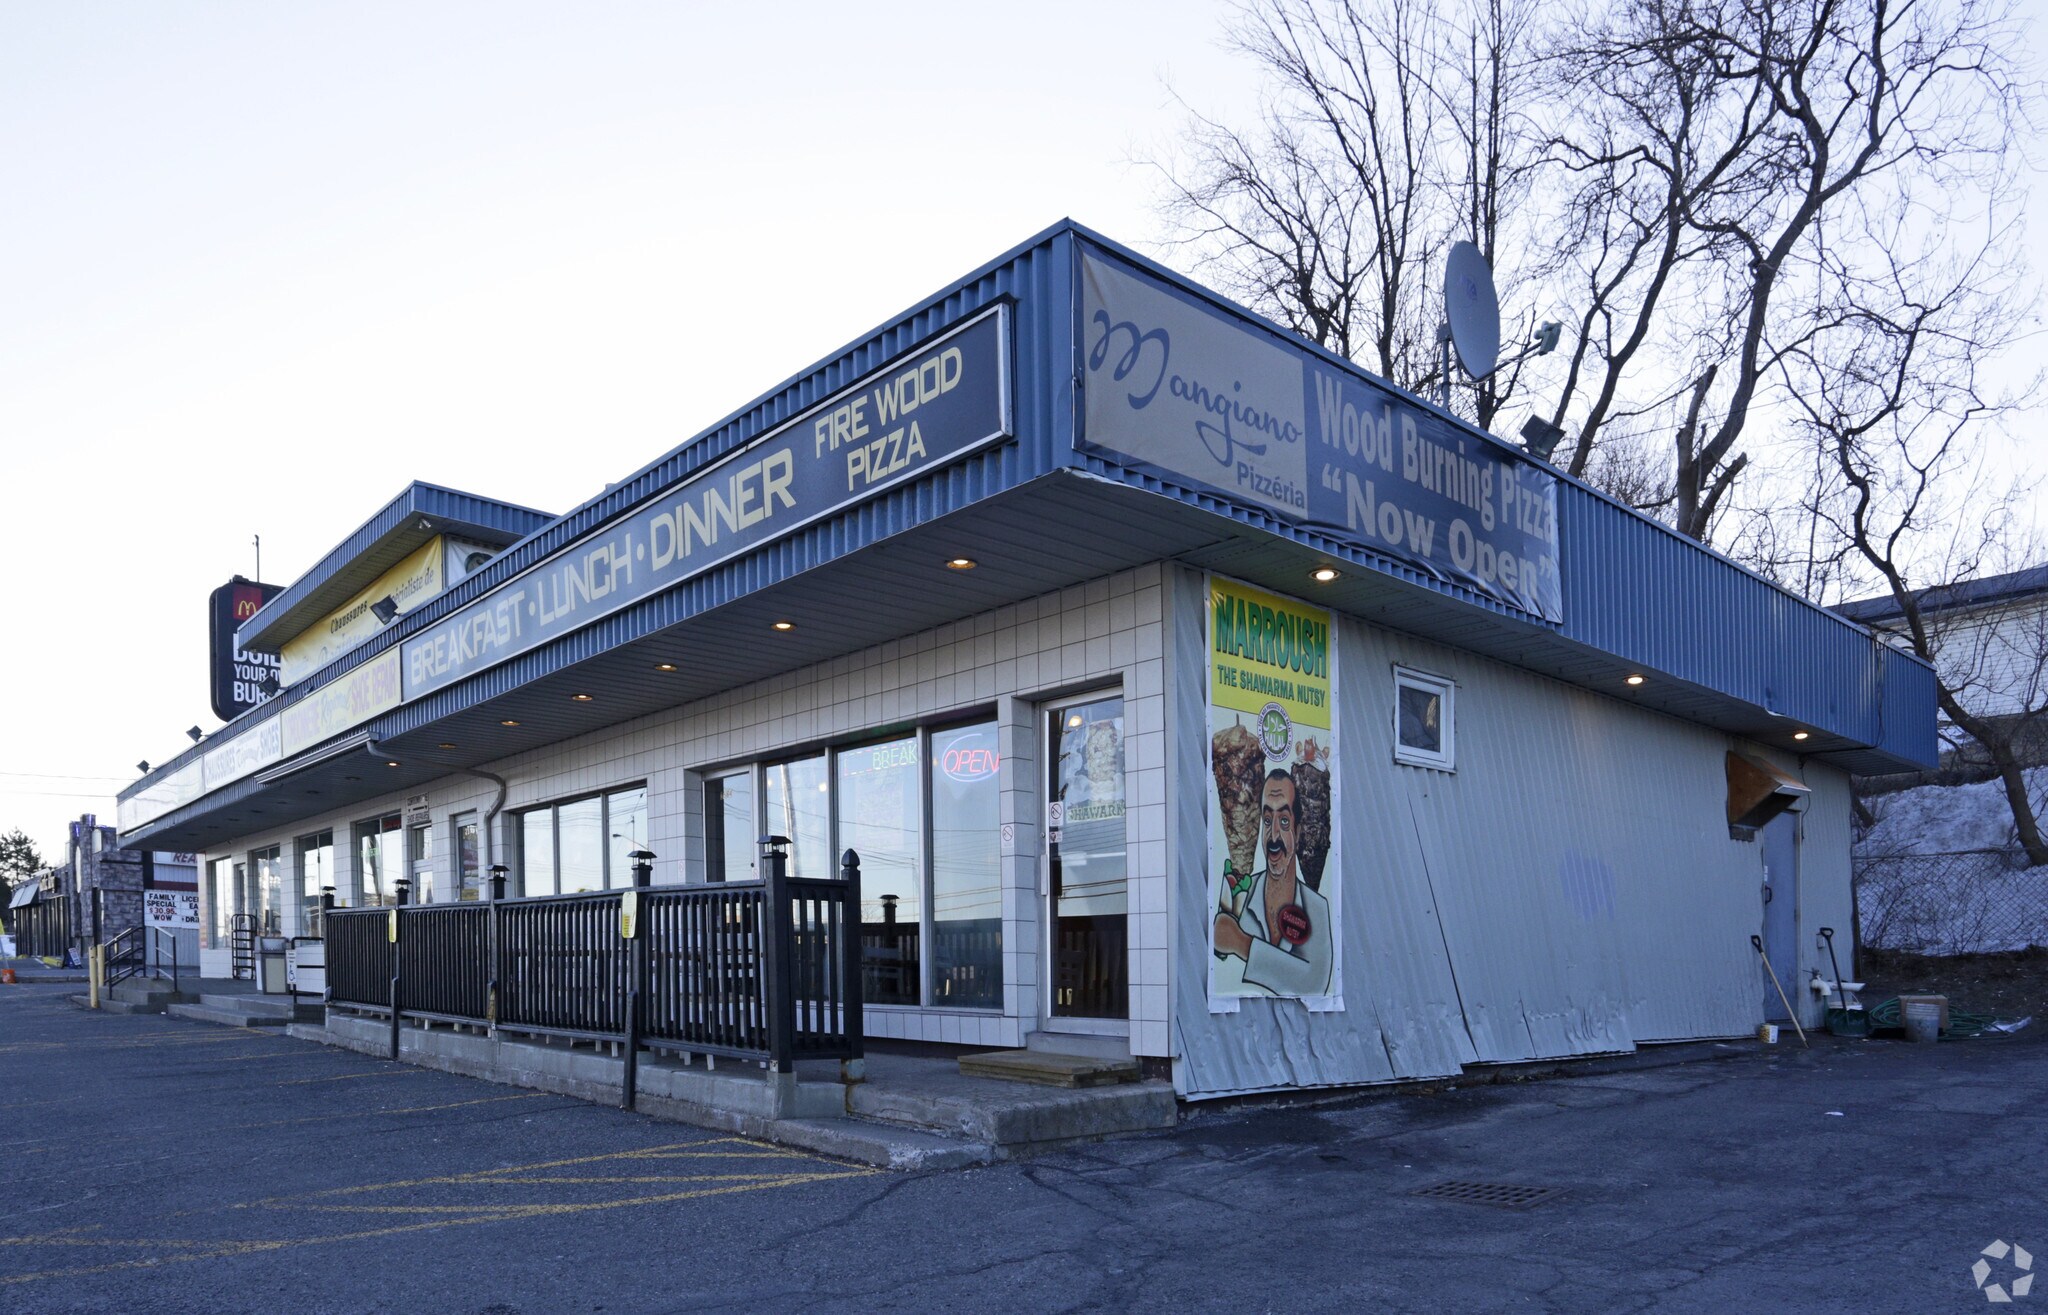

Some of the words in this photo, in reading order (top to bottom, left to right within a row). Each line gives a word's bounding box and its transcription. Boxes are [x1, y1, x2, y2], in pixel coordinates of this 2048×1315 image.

[814, 393, 869, 459] FIRE
[874, 346, 963, 427] WOOD
[1089, 309, 1303, 468] Mangiano
[847, 420, 927, 492] PIZZA
[1314, 369, 1394, 473] Wood
[1401, 412, 1496, 532] Burning
[1500, 462, 1553, 544] Pizza
[1236, 461, 1305, 510] Pizzéria
[411, 590, 525, 687] BREAKFAST
[537, 533, 633, 627] LUNCH
[650, 447, 797, 573] DINNER
[424, 566, 435, 586] de
[330, 600, 368, 635] Chaussures
[1215, 592, 1327, 680] MARROUSH
[233, 663, 267, 683] YOUR
[1217, 664, 1238, 688] THE
[1239, 669, 1295, 701] SHAWARMA
[1297, 684, 1326, 708] NUTSY
[943, 749, 1000, 773] OPEN
[1264, 730, 1286, 751] HALAL
[173, 852, 197, 863] REA
